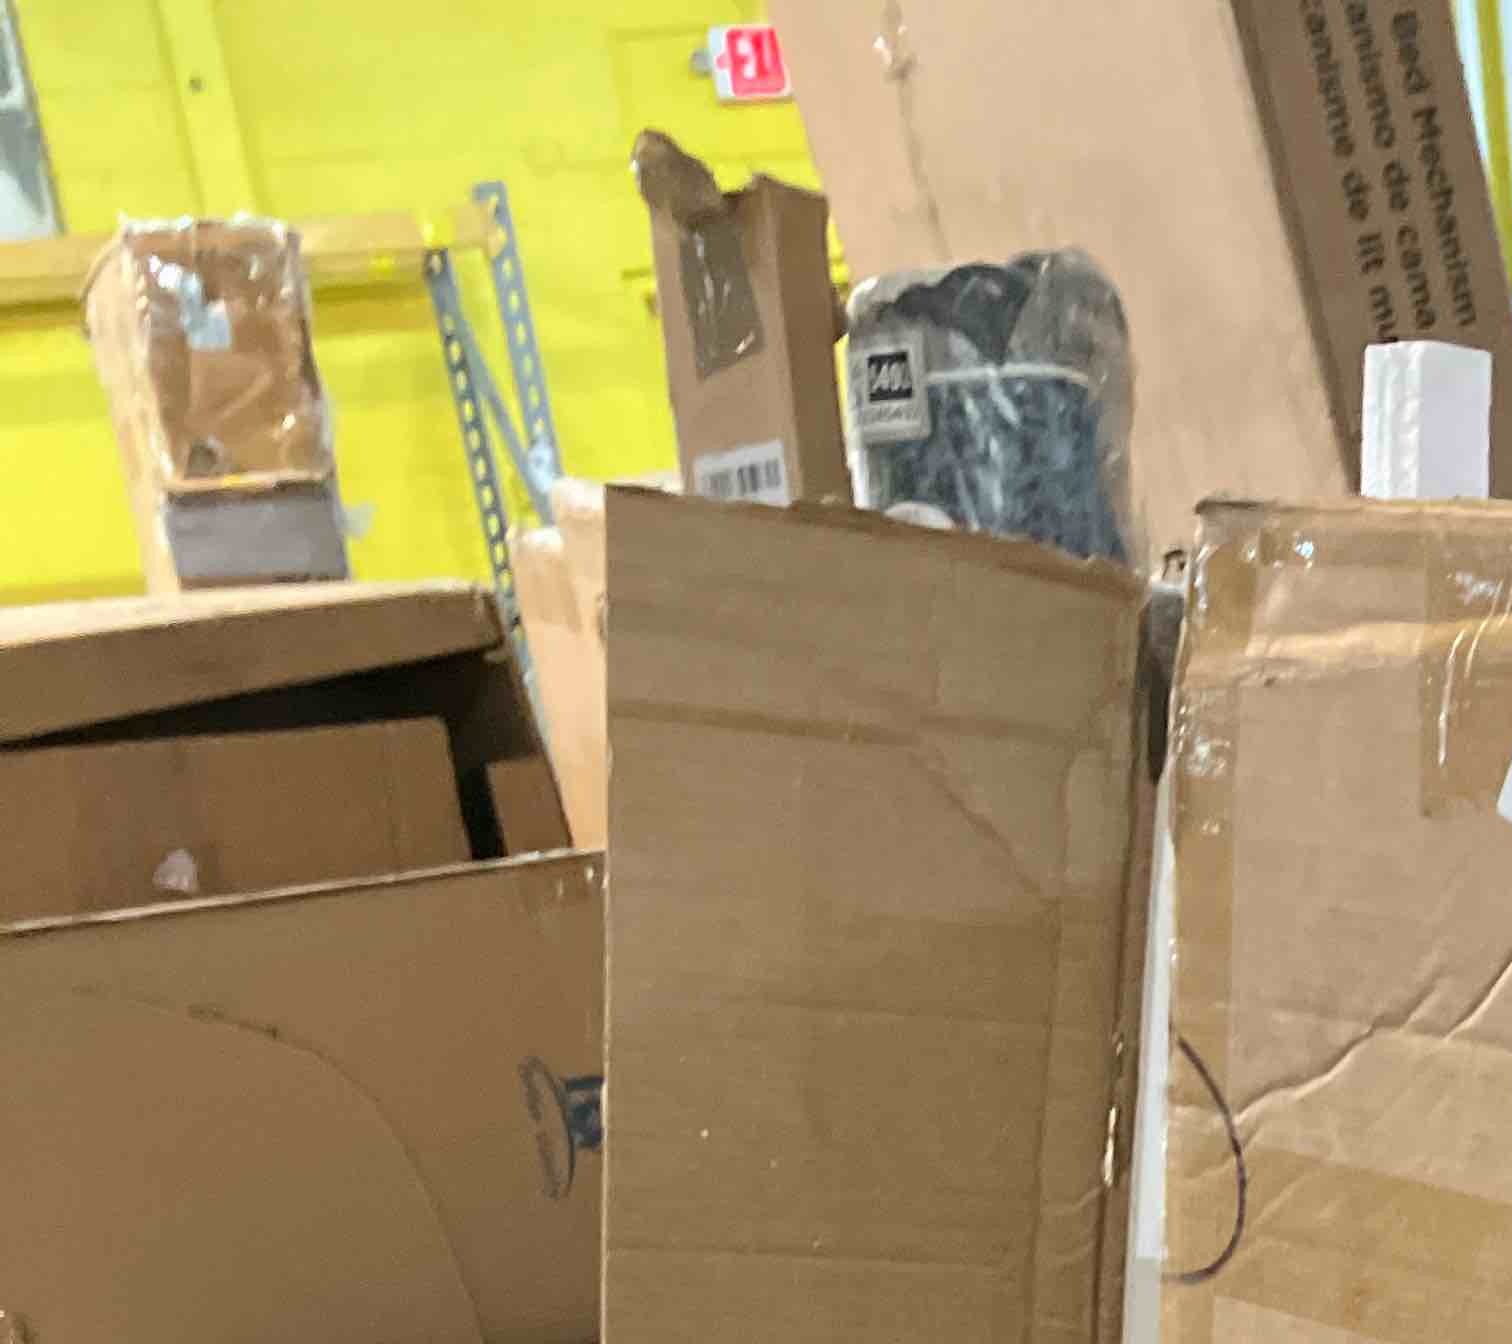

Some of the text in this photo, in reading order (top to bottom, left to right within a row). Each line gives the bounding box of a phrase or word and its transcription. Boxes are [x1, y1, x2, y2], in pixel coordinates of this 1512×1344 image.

[1342, 170, 1372, 221] de
[1357, 231, 1386, 275] lit
[1382, 159, 1411, 211] de
[1397, 223, 1436, 330] cama
[1392, 10, 1477, 327] Bed Mechanism
